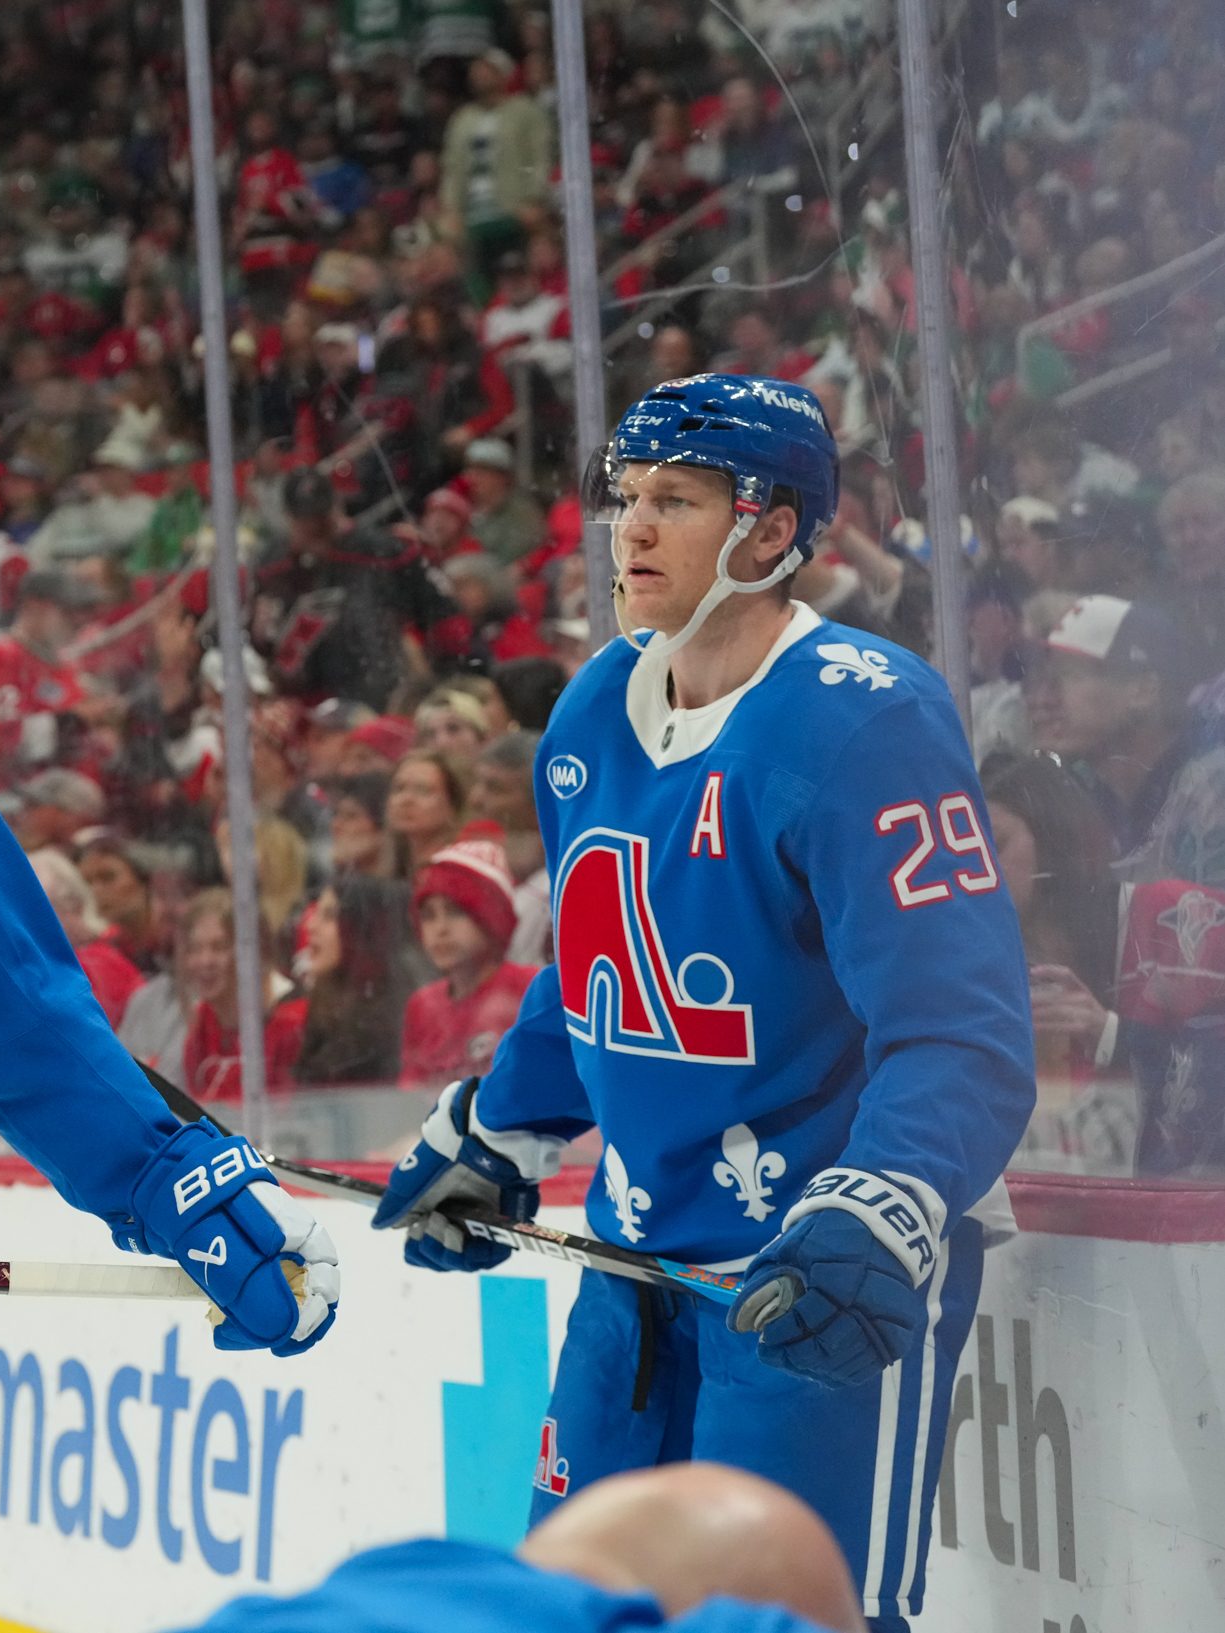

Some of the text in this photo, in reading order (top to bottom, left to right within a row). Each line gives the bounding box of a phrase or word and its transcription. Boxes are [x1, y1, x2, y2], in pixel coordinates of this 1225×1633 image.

[625, 415, 664, 426] CCM
[552, 765, 577, 787] IMA
[689, 771, 726, 859] A
[873, 790, 1000, 911] 29
